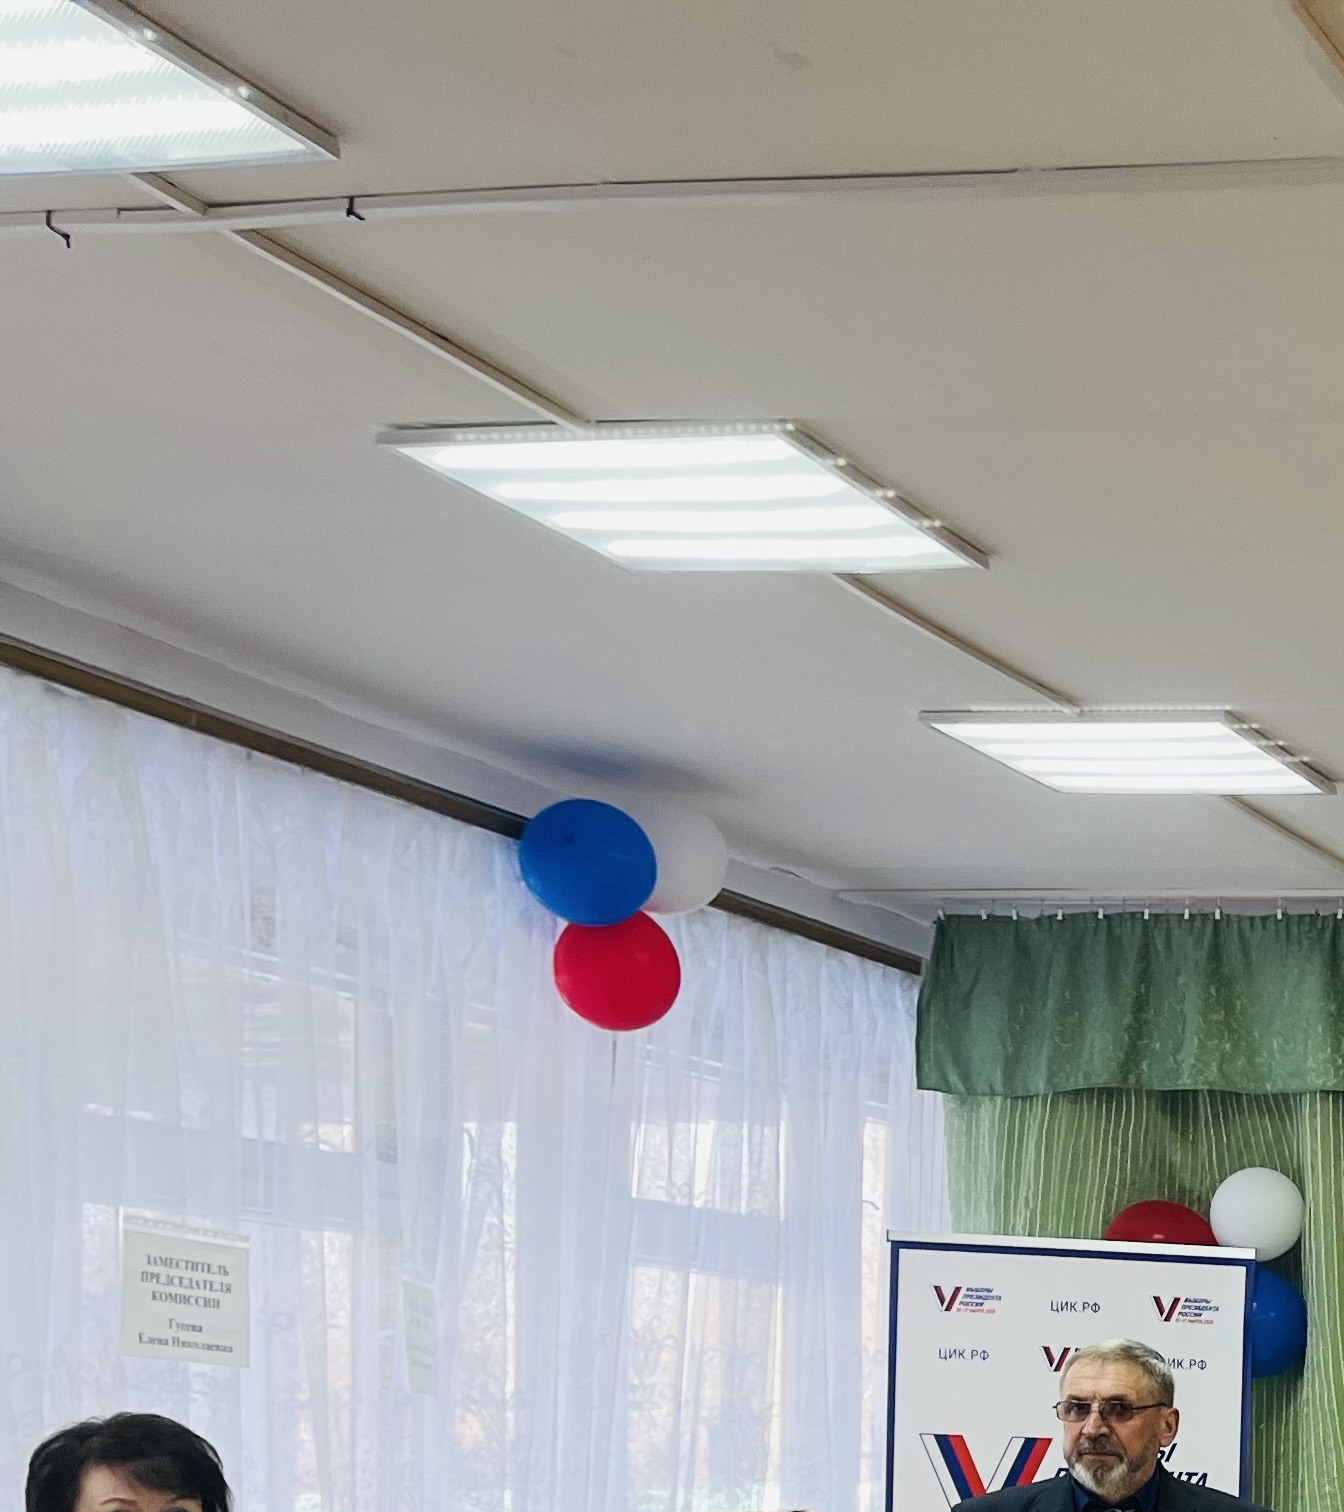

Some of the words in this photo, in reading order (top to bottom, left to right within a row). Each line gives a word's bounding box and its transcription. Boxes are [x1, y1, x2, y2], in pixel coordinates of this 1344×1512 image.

[151, 1290, 221, 1309] КОМИССИИ
[1050, 1300, 1101, 1314] ЦИК.РФ
[938, 1348, 990, 1361] ЦИК.РФ
[1167, 1358, 1207, 1371] ИК.РФ
